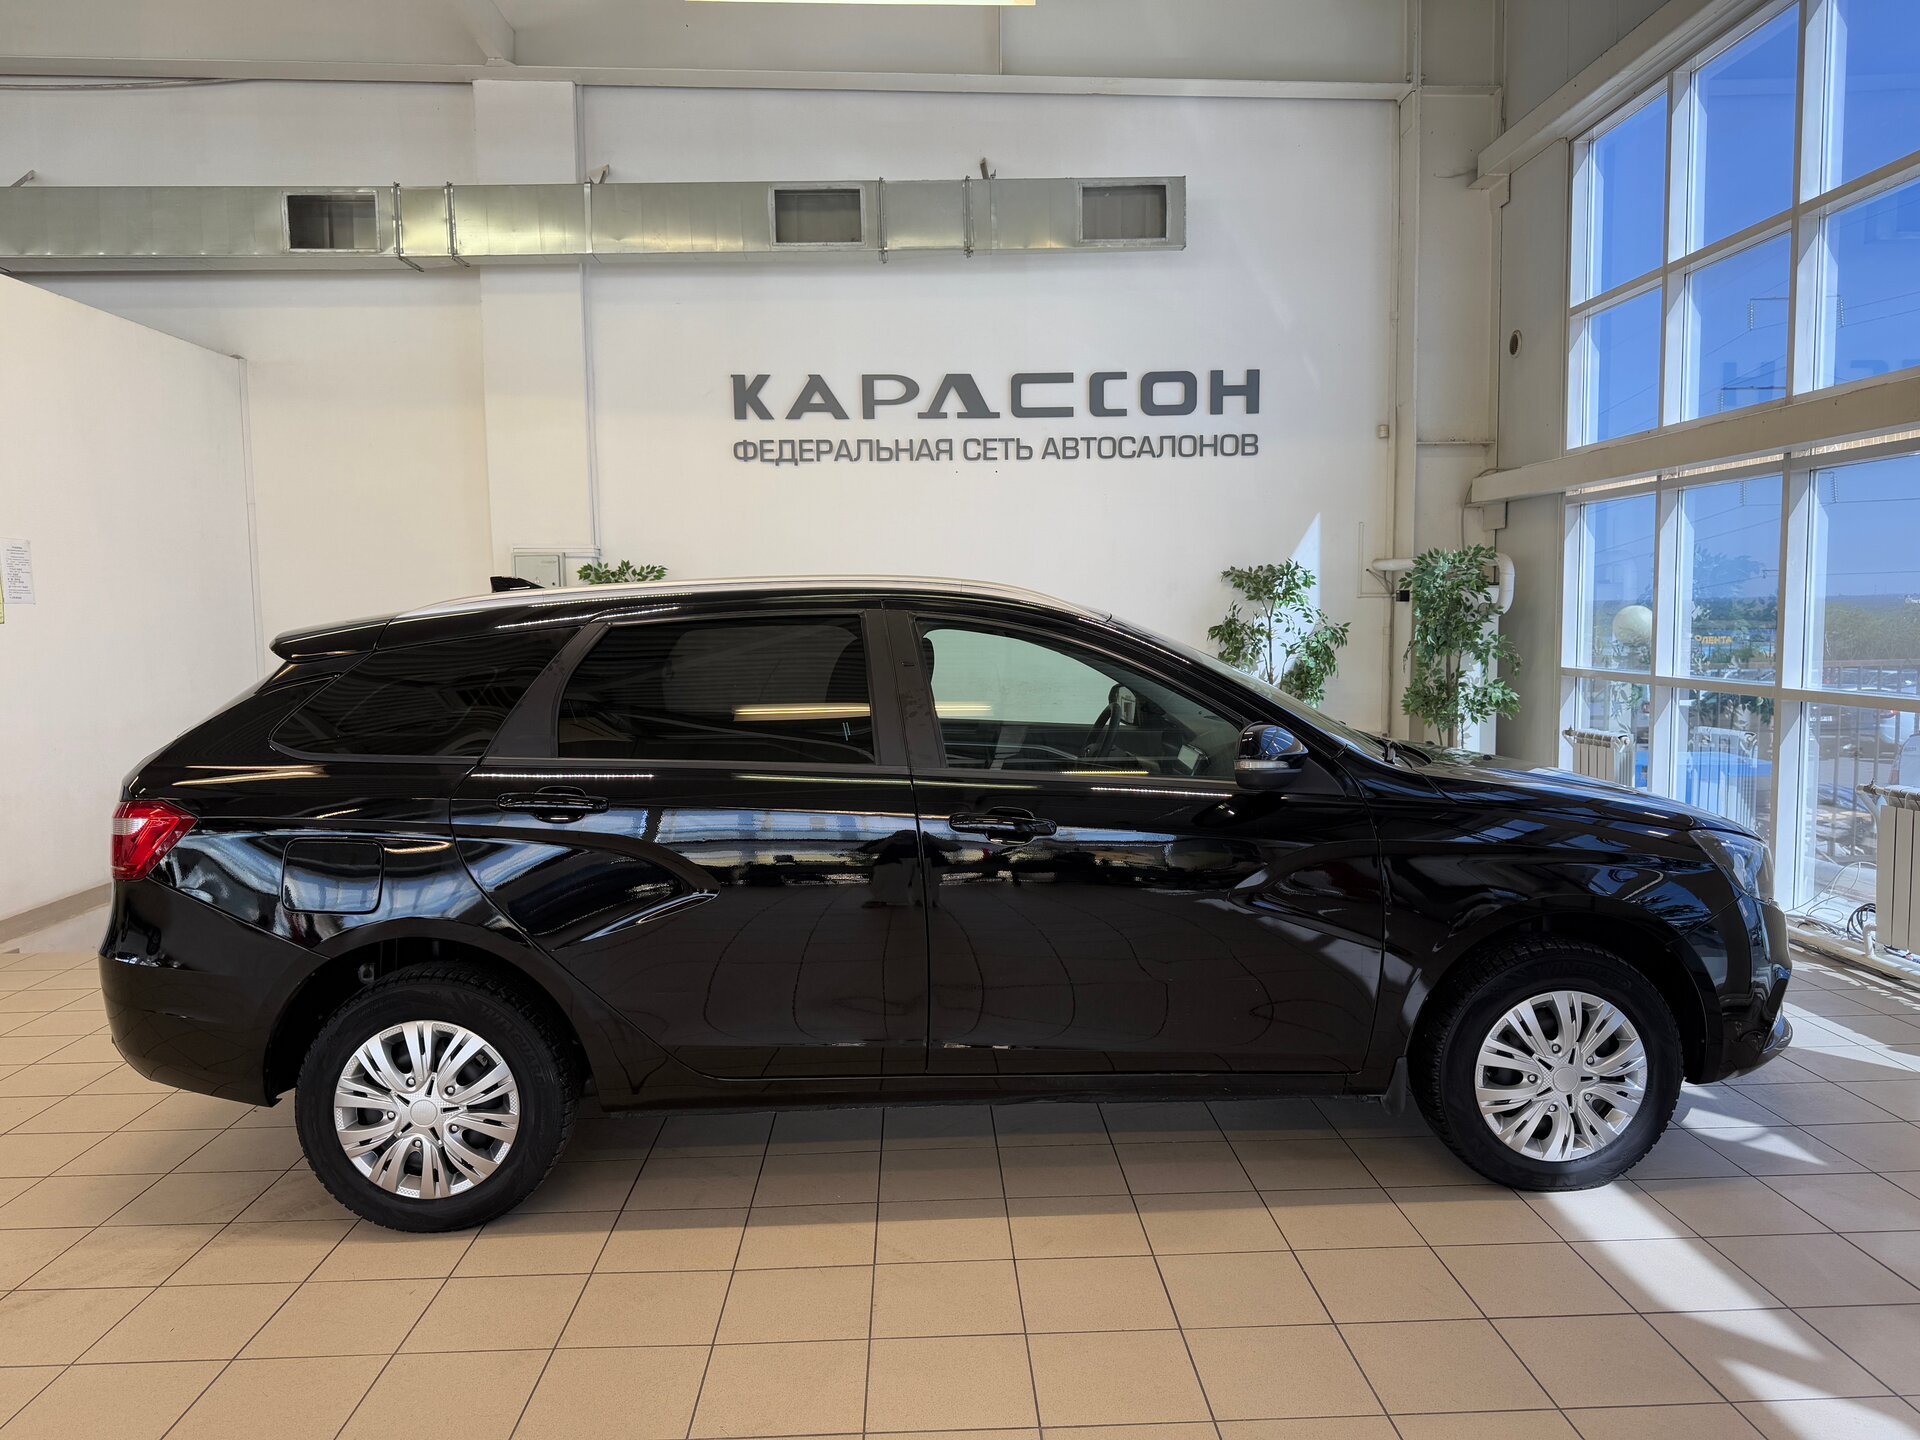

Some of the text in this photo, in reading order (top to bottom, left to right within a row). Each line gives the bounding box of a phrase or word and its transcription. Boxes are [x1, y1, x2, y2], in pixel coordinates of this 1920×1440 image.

[733, 434, 1259, 466] ФЕДЕРАЛЬНАЯ СЕТЬ АВТОСАЛОНОВ
